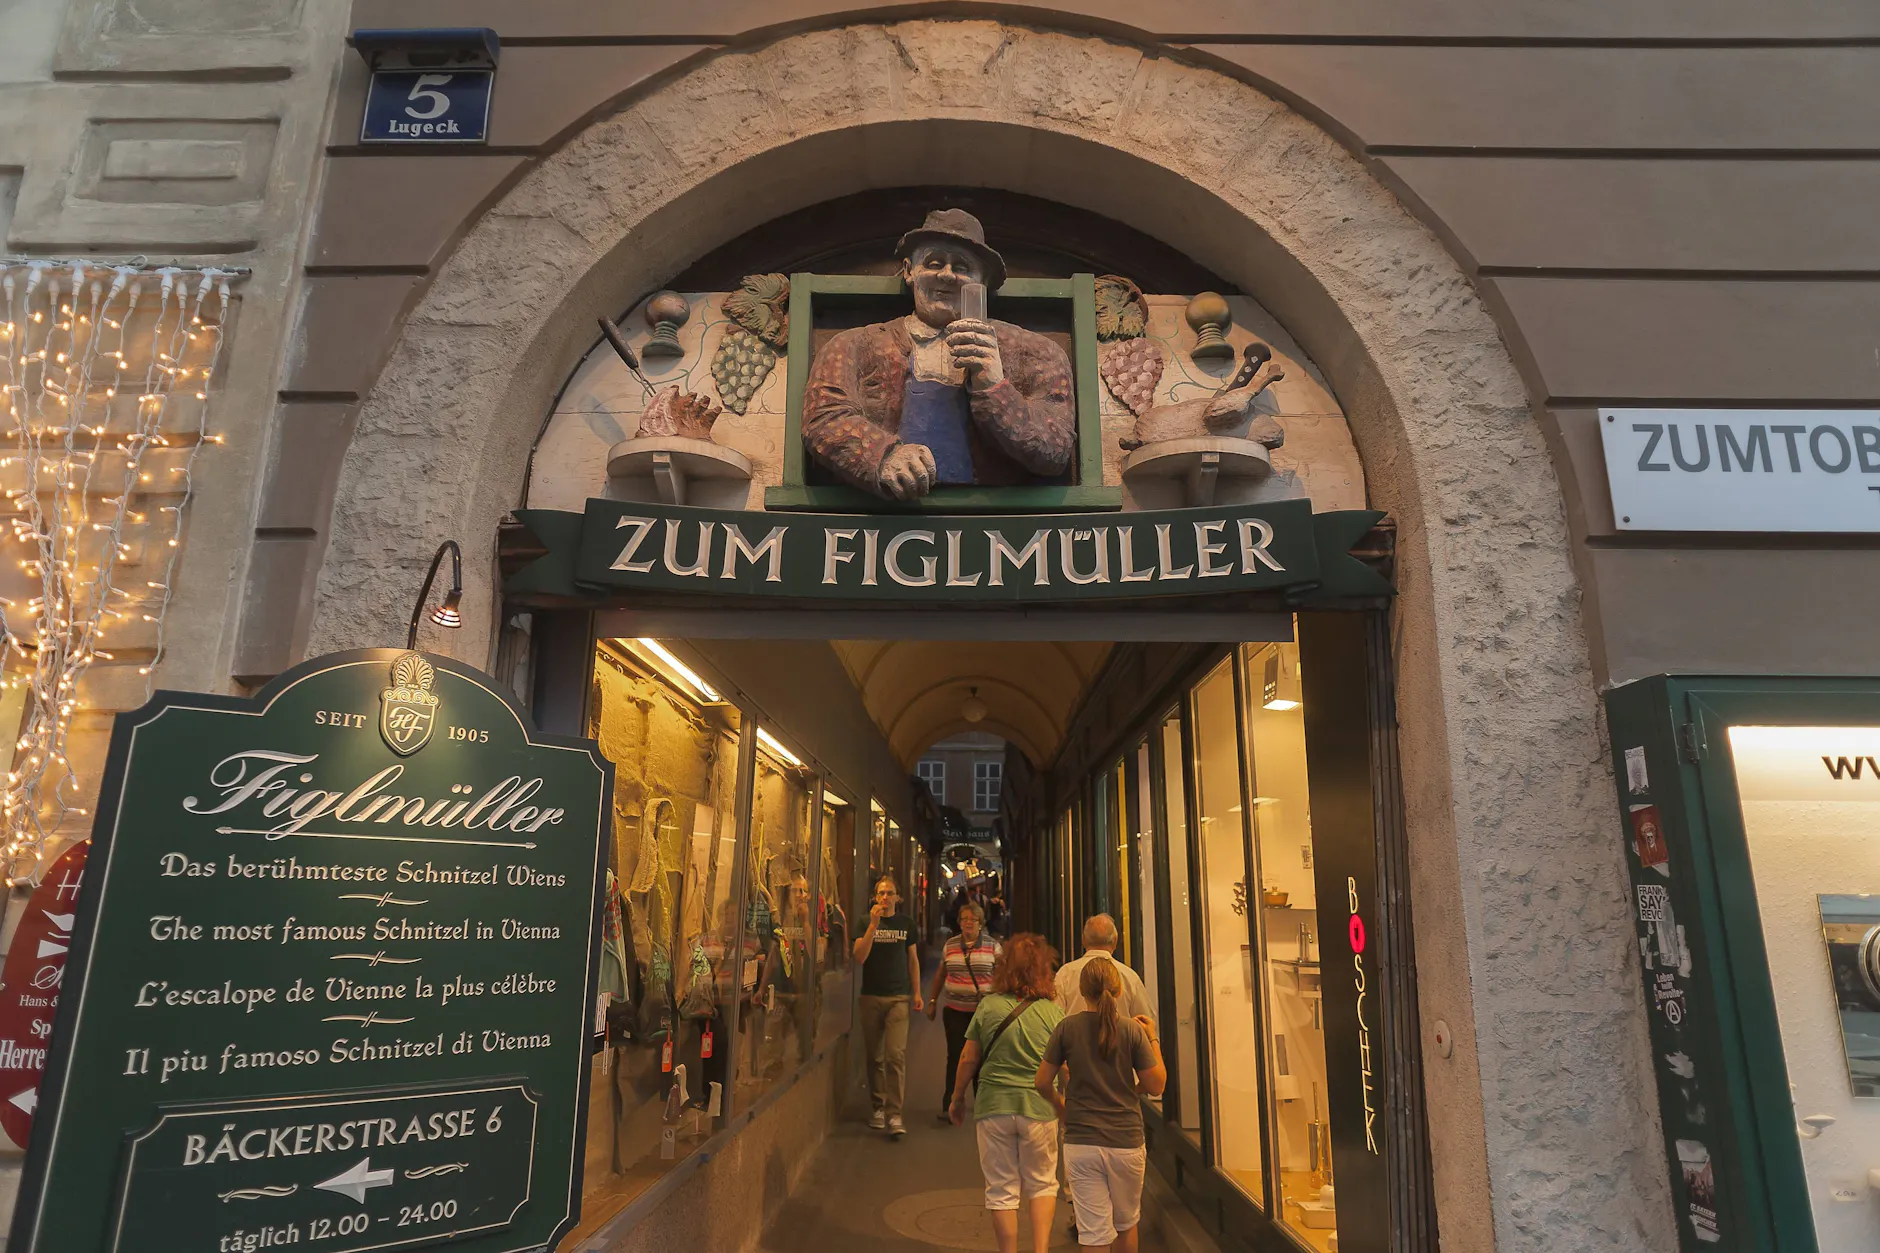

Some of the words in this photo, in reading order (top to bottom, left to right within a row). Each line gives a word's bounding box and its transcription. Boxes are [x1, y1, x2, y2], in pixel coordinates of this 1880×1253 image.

[405, 74, 453, 119] 5
[388, 119, 460, 137] Lugeck
[1632, 424, 1880, 473] ZUMTOB
[608, 515, 789, 582] ZUM
[821, 518, 1286, 586] FIGLMÜLLER
[315, 710, 367, 729] SEIT
[447, 725, 490, 744] 1905
[1821, 756, 1880, 780] w
[183, 749, 565, 841] Figlmüller
[160, 852, 217, 877] Das
[227, 853, 388, 882] berühmteste
[395, 859, 498, 885] Schnitzel
[506, 864, 566, 887] Wiens
[1640, 895, 1666, 909] SAY
[150, 915, 203, 941] The
[213, 923, 275, 941] most
[281, 916, 366, 944] famous
[373, 917, 469, 941] Schnitzel
[476, 920, 494, 940] in
[501, 918, 560, 940] Vienna
[19, 994, 48, 1007] Hans
[134, 979, 276, 1014] L'escalope
[285, 978, 315, 1003] de
[325, 977, 406, 1001] Vienne
[415, 975, 434, 998] la
[441, 974, 484, 1006] plus
[491, 972, 557, 994] célèbre
[31, 1018, 52, 1039] Sp
[1347, 876, 1379, 1156] BOSCHEK
[0, 1040, 47, 1069] Herre
[122, 1047, 150, 1075] Il
[160, 1049, 208, 1084] piu
[219, 1043, 320, 1074] famoso
[329, 1032, 444, 1063] Schnitzel
[452, 1031, 473, 1055] di
[482, 1029, 552, 1052] Vienna
[183, 1107, 476, 1166] BÄCKERSTRASSE
[485, 1105, 503, 1133] 6
[219, 1222, 300, 1253] täglich
[308, 1212, 369, 1241] 12.00
[397, 1199, 458, 1227] 24.00
